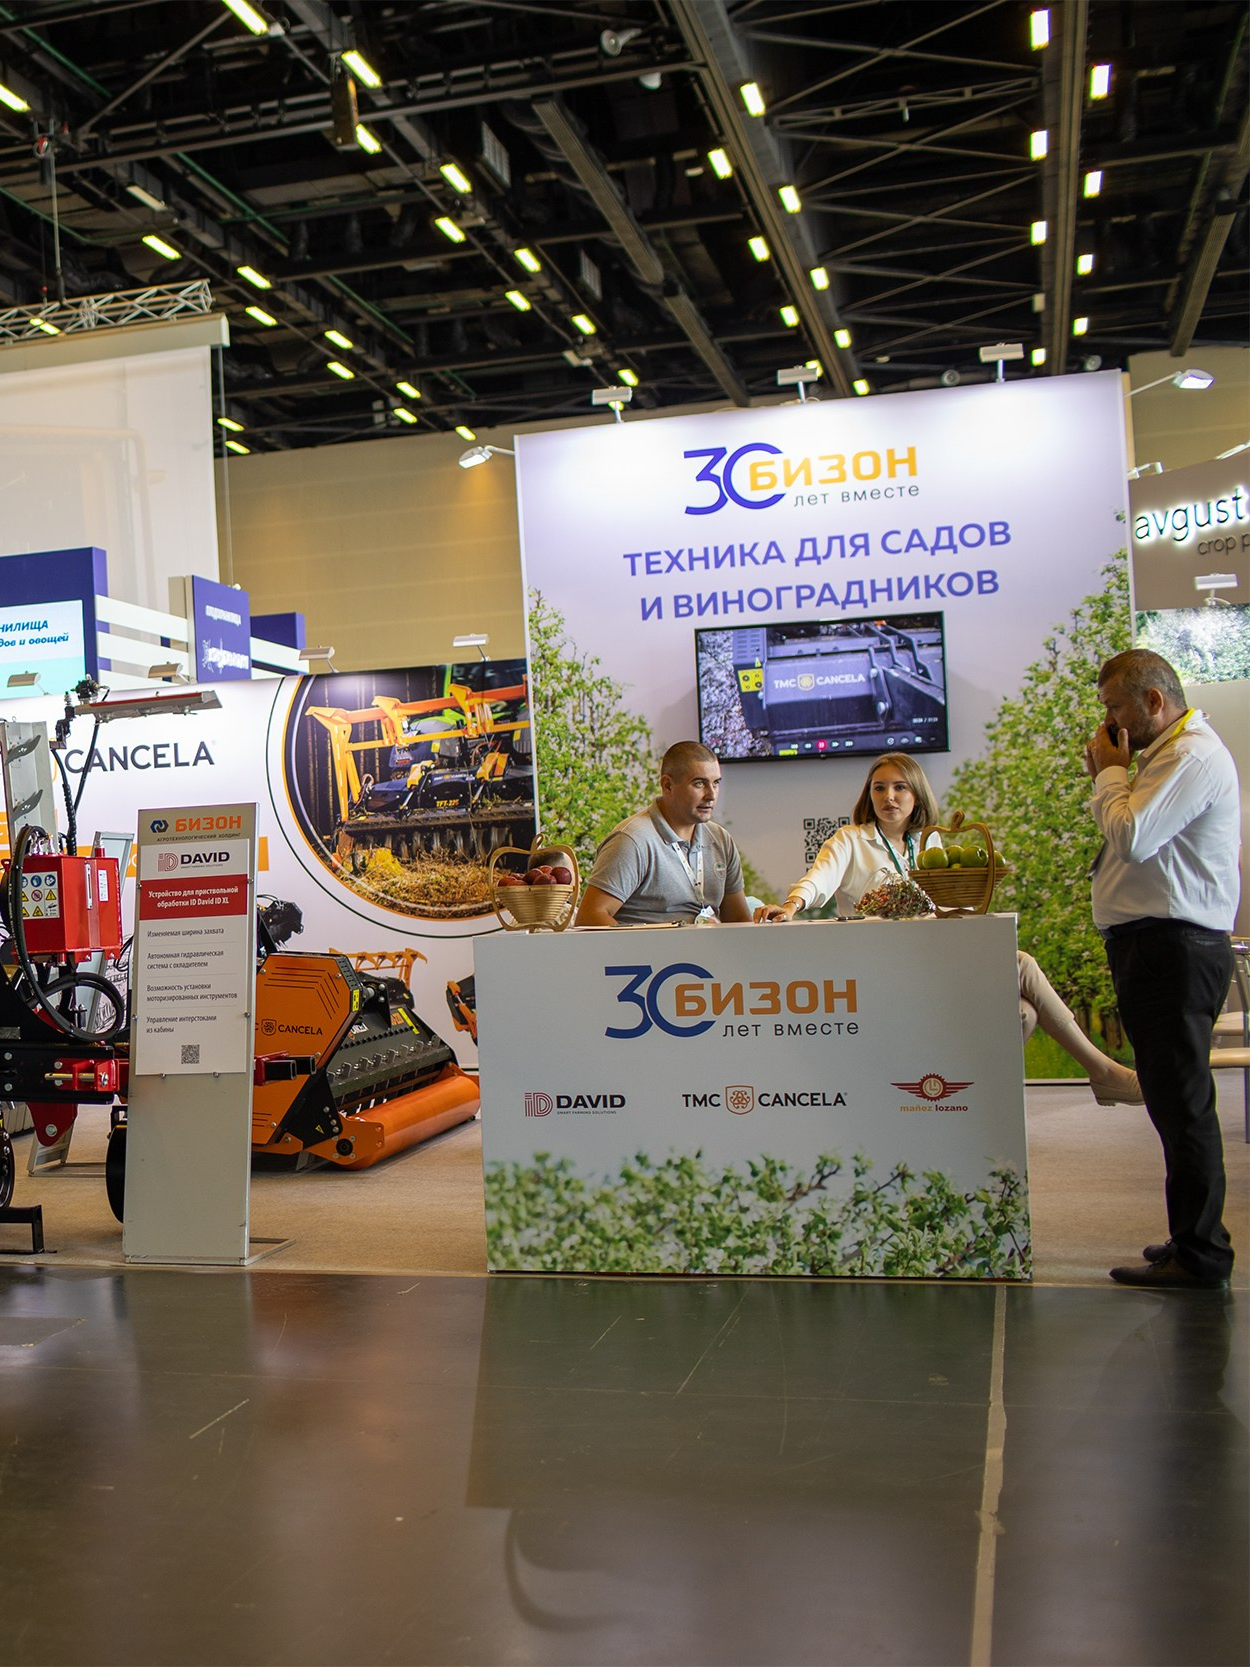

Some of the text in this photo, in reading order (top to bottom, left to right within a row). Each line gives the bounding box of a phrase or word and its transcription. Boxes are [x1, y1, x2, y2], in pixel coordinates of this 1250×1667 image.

[749, 446, 918, 491] БИЗОН
[794, 484, 920, 507] лет вместе
[1134, 488, 1247, 542] avgust
[623, 520, 1013, 577] ТЕХНИКА ДЛЯ САДОВ
[1197, 535, 1236, 556] crop
[640, 569, 1000, 621] И ВИНОГРАДНИКОВ
[28, 632, 69, 645] овощей
[773, 673, 866, 689] TMC CANCELA
[64, 741, 215, 775] CANCELA
[175, 815, 242, 832] БИЗОН
[180, 851, 230, 865] DAVID
[148, 889, 182, 898] Устройство
[183, 889, 194, 897] для
[197, 897, 214, 905] David
[674, 979, 858, 1017] БИЗОН
[278, 1023, 323, 1035] CANCELA
[722, 1022, 859, 1037] лет вместе
[556, 1094, 626, 1109] DAVID
[682, 1092, 847, 1107] TMC CANCELA
[935, 1104, 969, 1112] lozano
